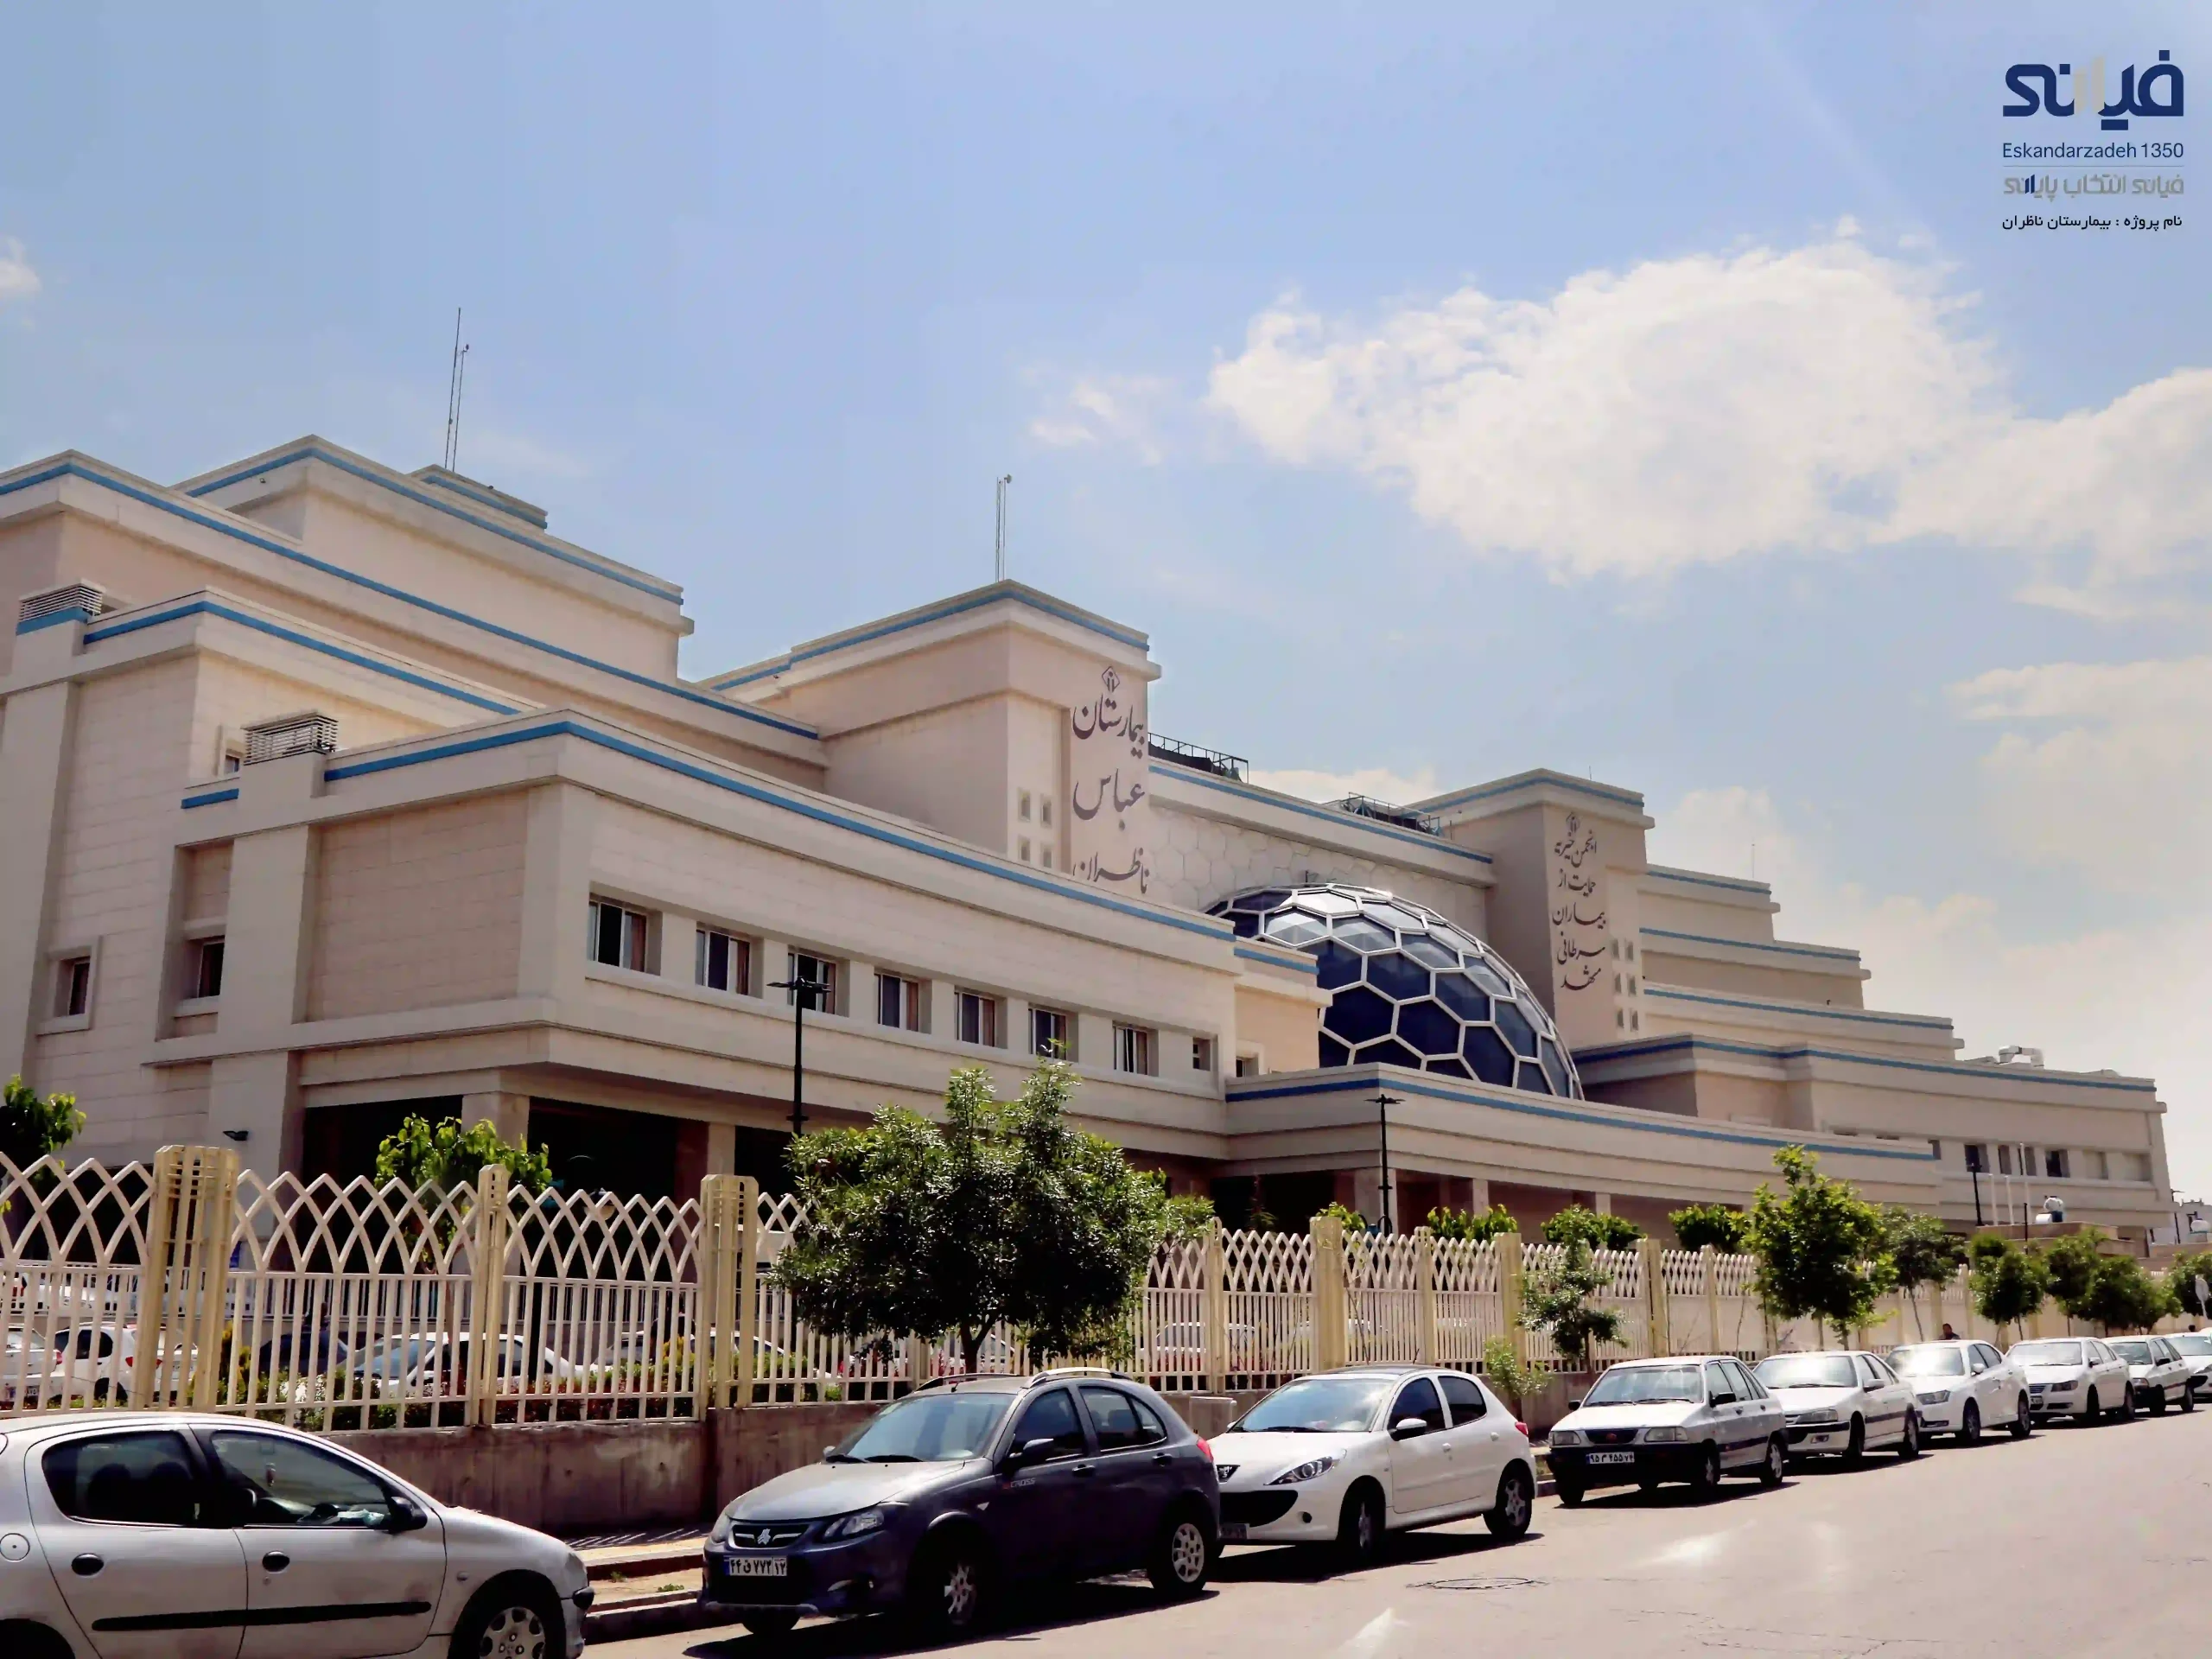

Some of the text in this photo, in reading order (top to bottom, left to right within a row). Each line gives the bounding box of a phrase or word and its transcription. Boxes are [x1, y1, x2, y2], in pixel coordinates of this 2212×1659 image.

[1072, 694, 1146, 759] بیمارستان
[1072, 768, 1146, 830] عباس
[1552, 901, 1606, 930] بیماران
[1556, 931, 1605, 965] سرطانی
[1560, 964, 1602, 991] مشهد
